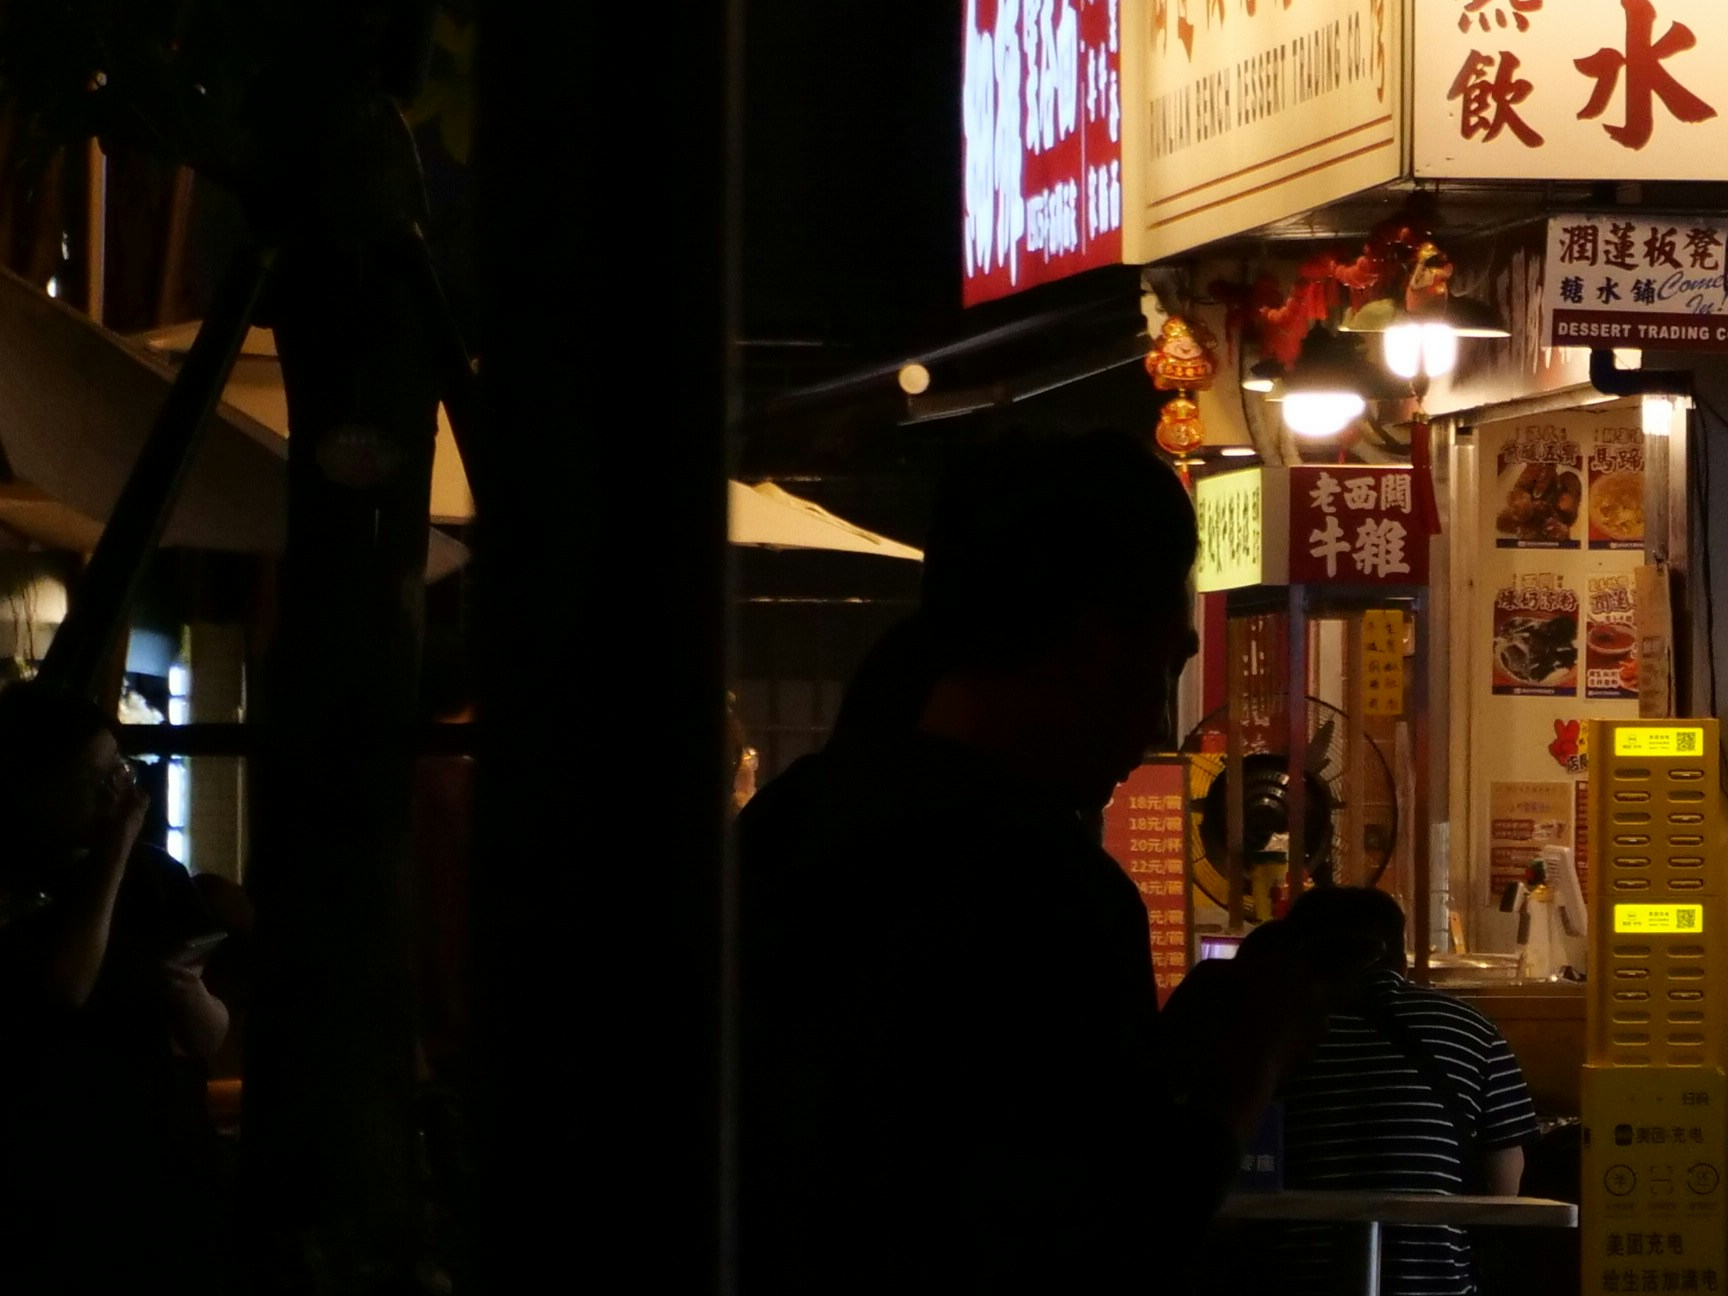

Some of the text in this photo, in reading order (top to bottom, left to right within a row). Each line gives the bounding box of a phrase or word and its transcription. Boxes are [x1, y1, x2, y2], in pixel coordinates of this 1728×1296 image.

[1195, 68, 1232, 146] BENCH
[1236, 44, 1287, 130] DESSERT
[1291, 19, 1341, 107] TRADING
[1346, 11, 1367, 84] CO.
[1559, 220, 1723, 271] 潤蓮板凳
[1558, 321, 1630, 338] DESSERT
[1637, 323, 1710, 341] TRADING
[1308, 517, 1412, 579] 牛雜
